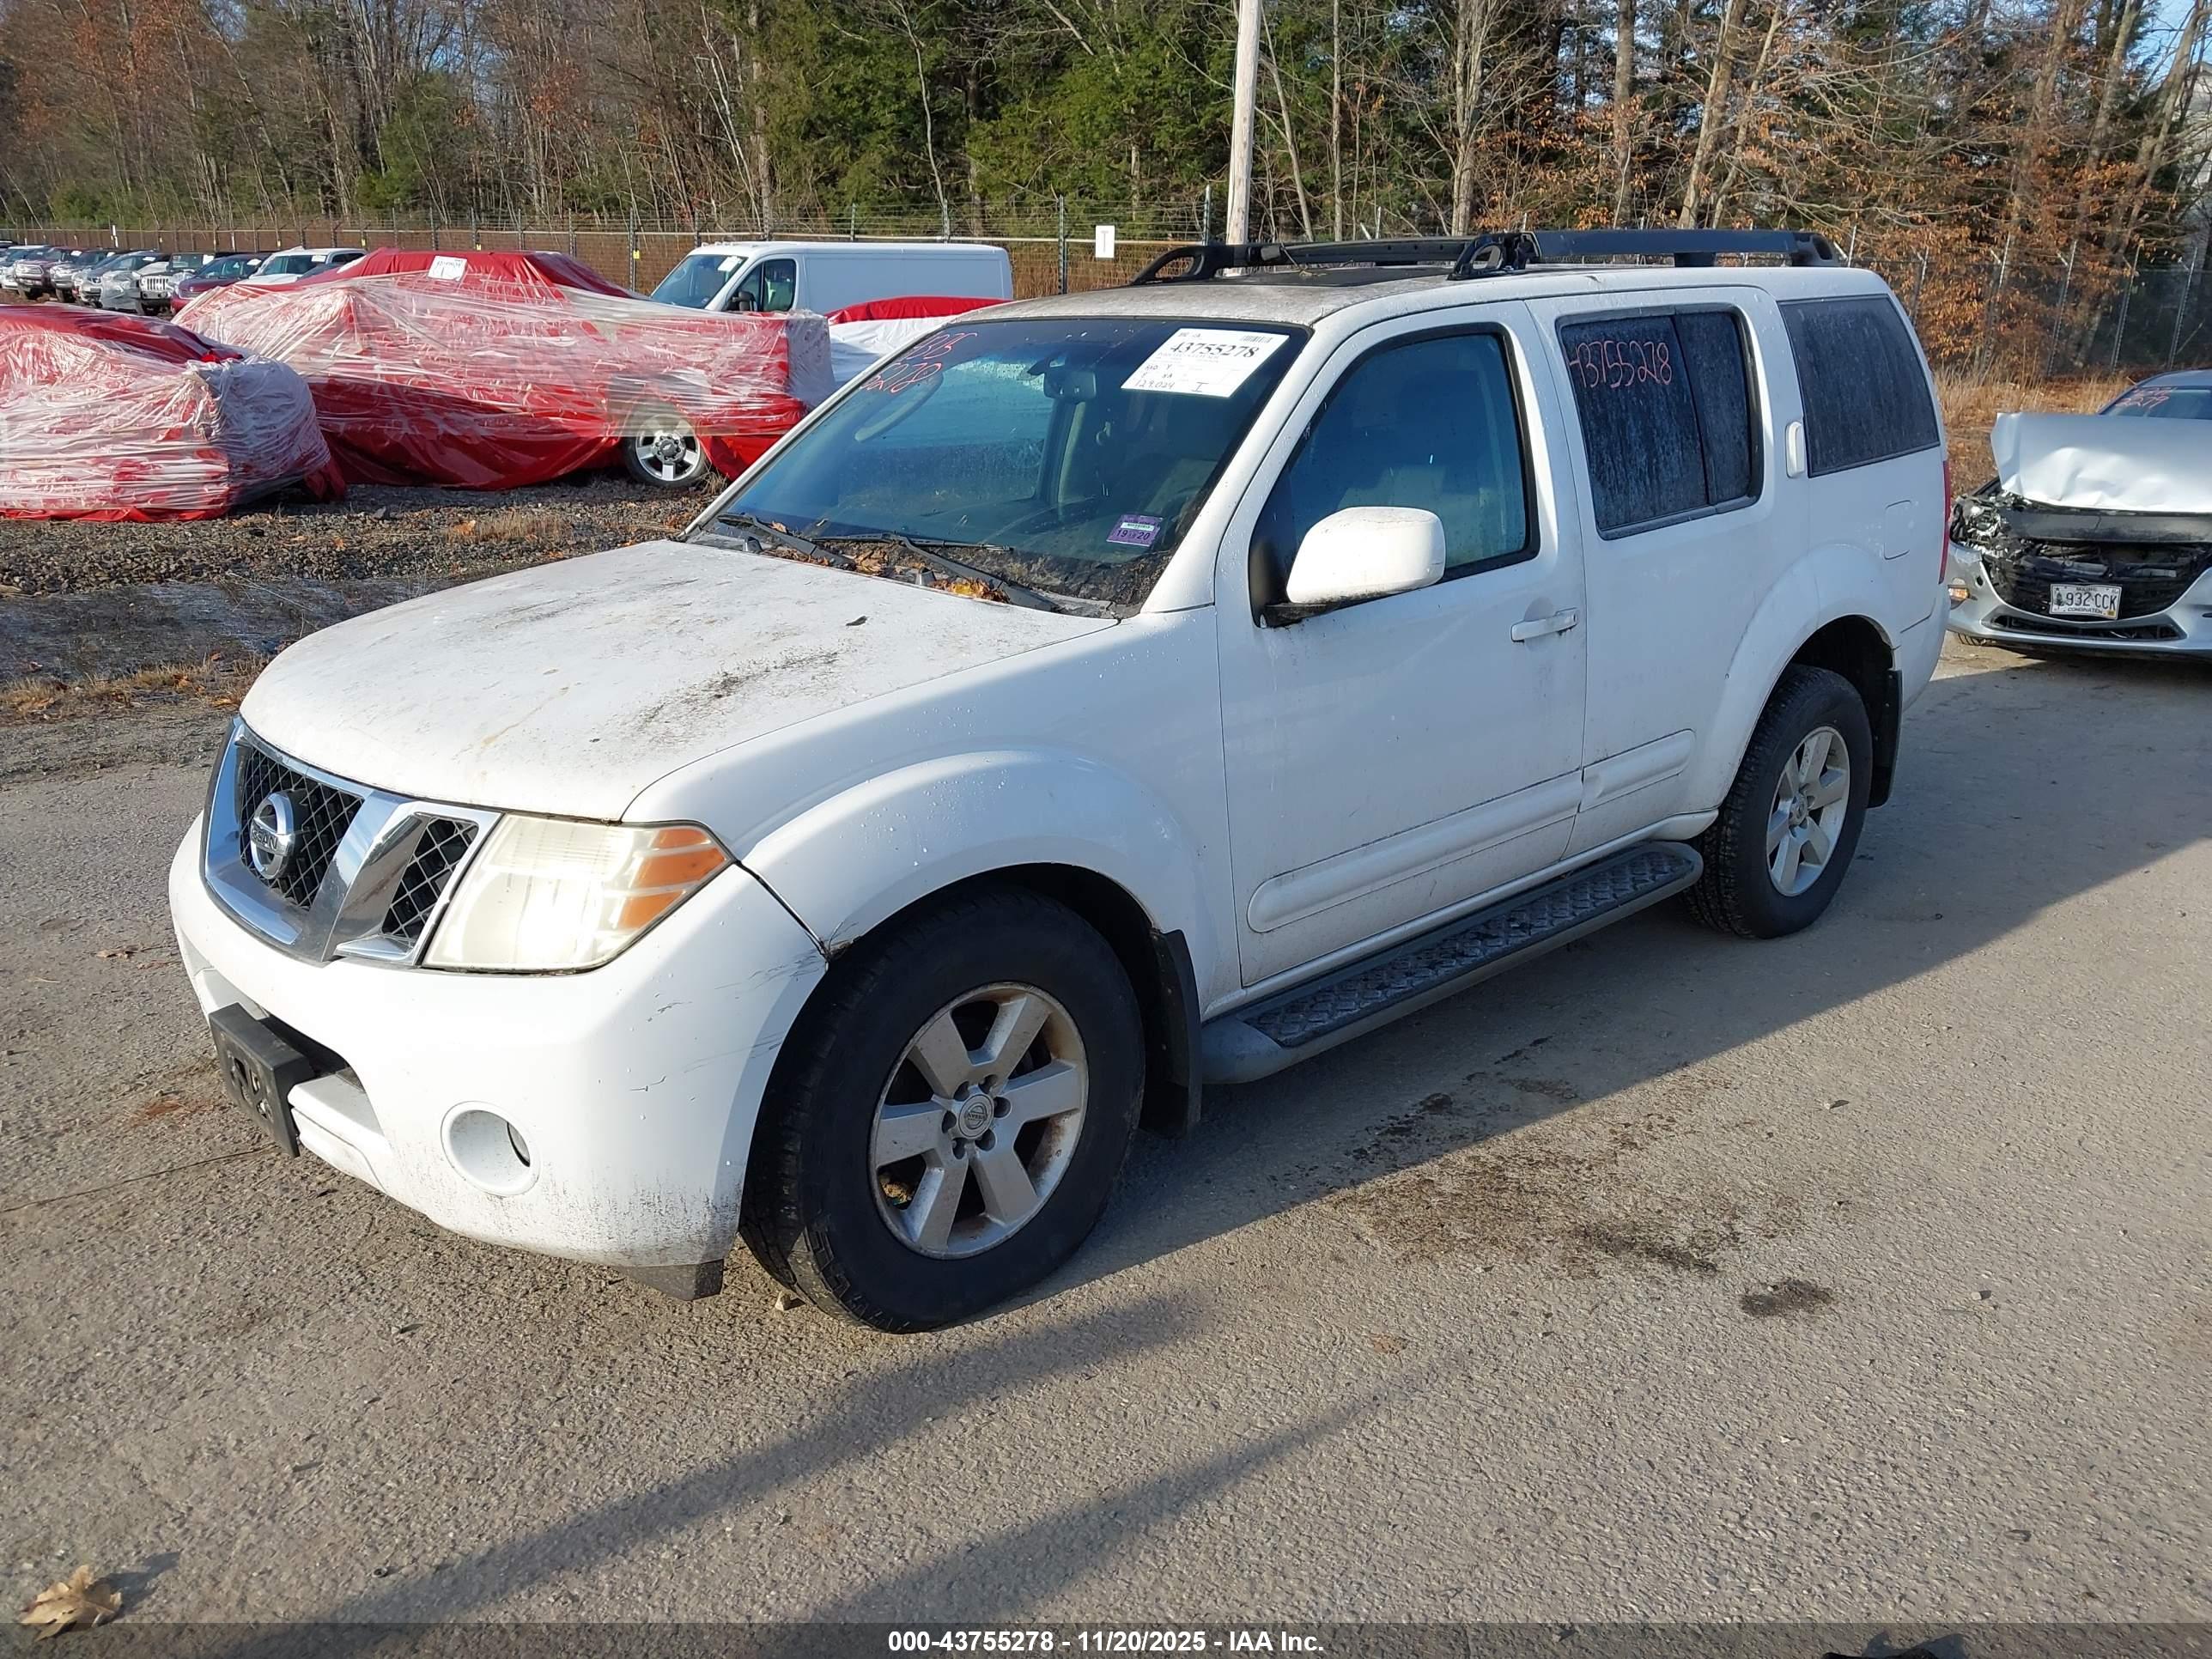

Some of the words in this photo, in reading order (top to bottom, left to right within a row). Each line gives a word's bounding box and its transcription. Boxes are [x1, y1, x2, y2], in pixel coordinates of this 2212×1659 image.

[1170, 342, 1259, 358] 43755278
[1570, 340, 1673, 388] 43755278
[1116, 529, 1128, 538] 19
[1136, 532, 1151, 540] 20
[2066, 592, 2091, 606] 932
[2094, 592, 2118, 611] CCK
